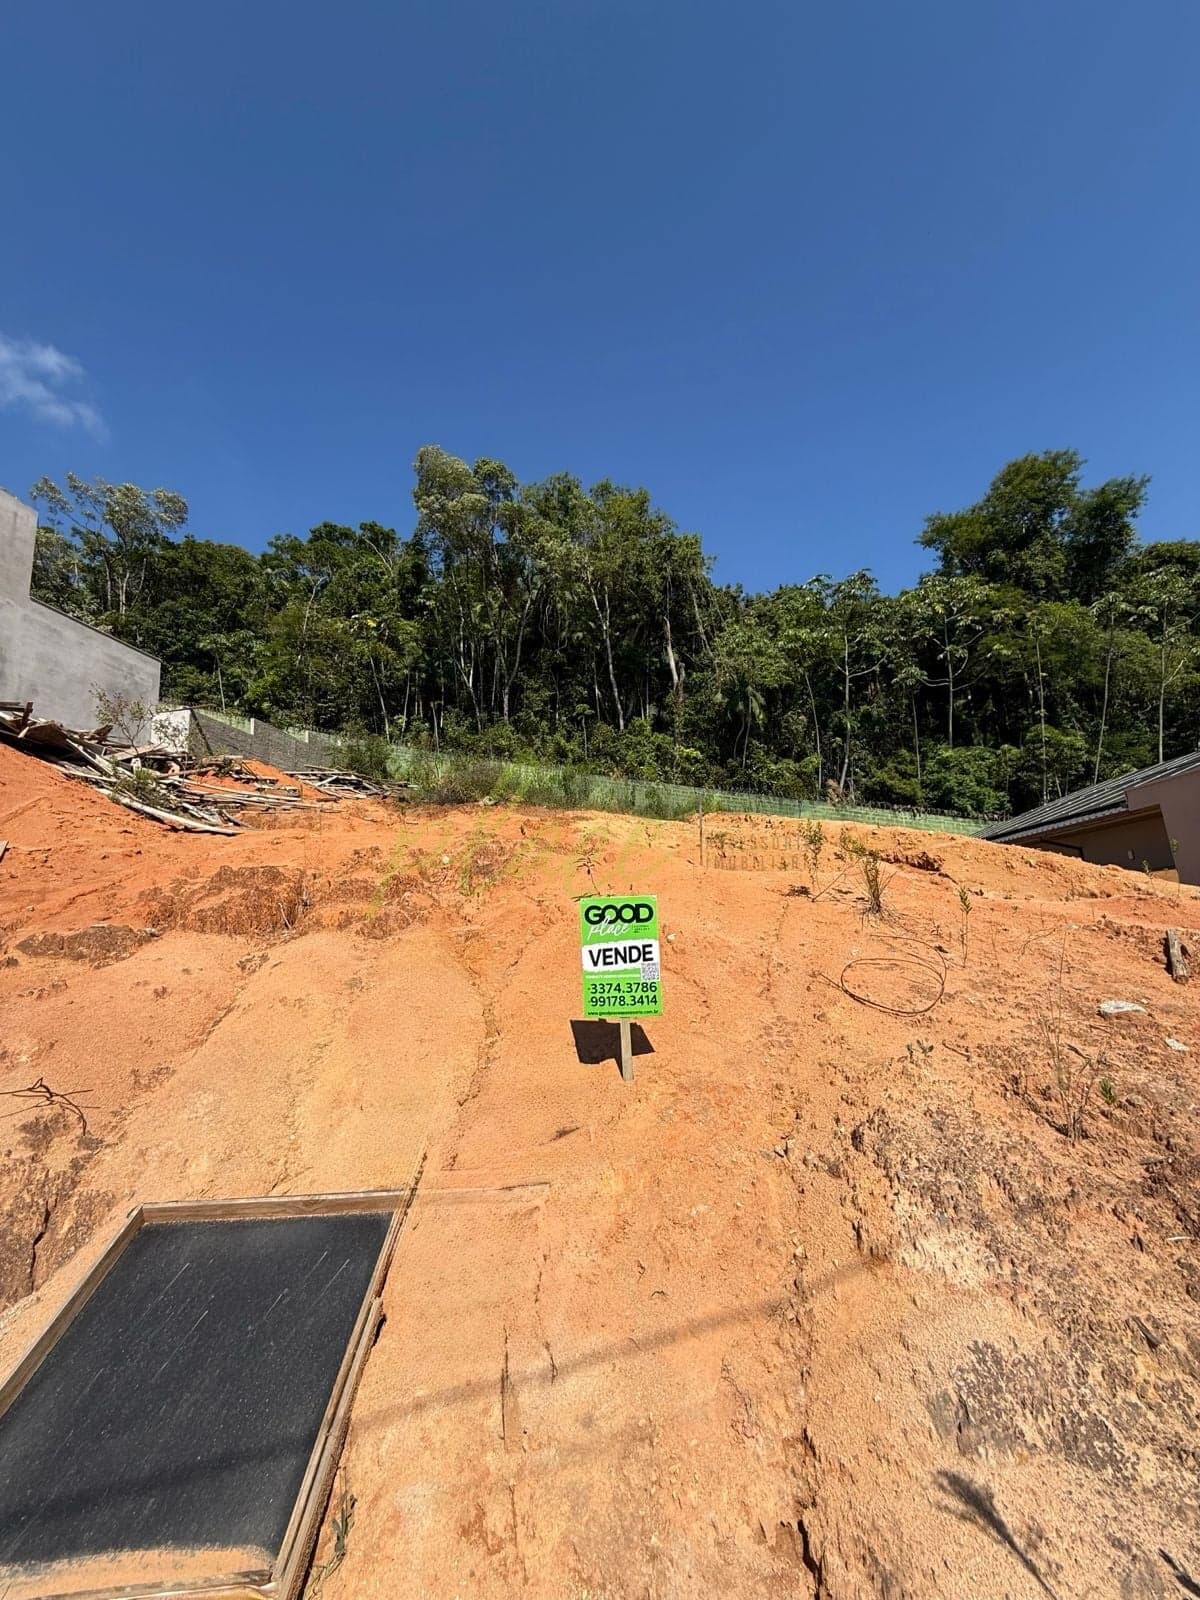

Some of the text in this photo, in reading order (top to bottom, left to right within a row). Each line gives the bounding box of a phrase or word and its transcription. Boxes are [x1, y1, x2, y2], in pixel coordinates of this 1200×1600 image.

[584, 903, 654, 925] GOOD
[588, 944, 653, 967] VENDE
[590, 982, 657, 994] 3374.3786
[590, 995, 657, 1007] 99178.3414
